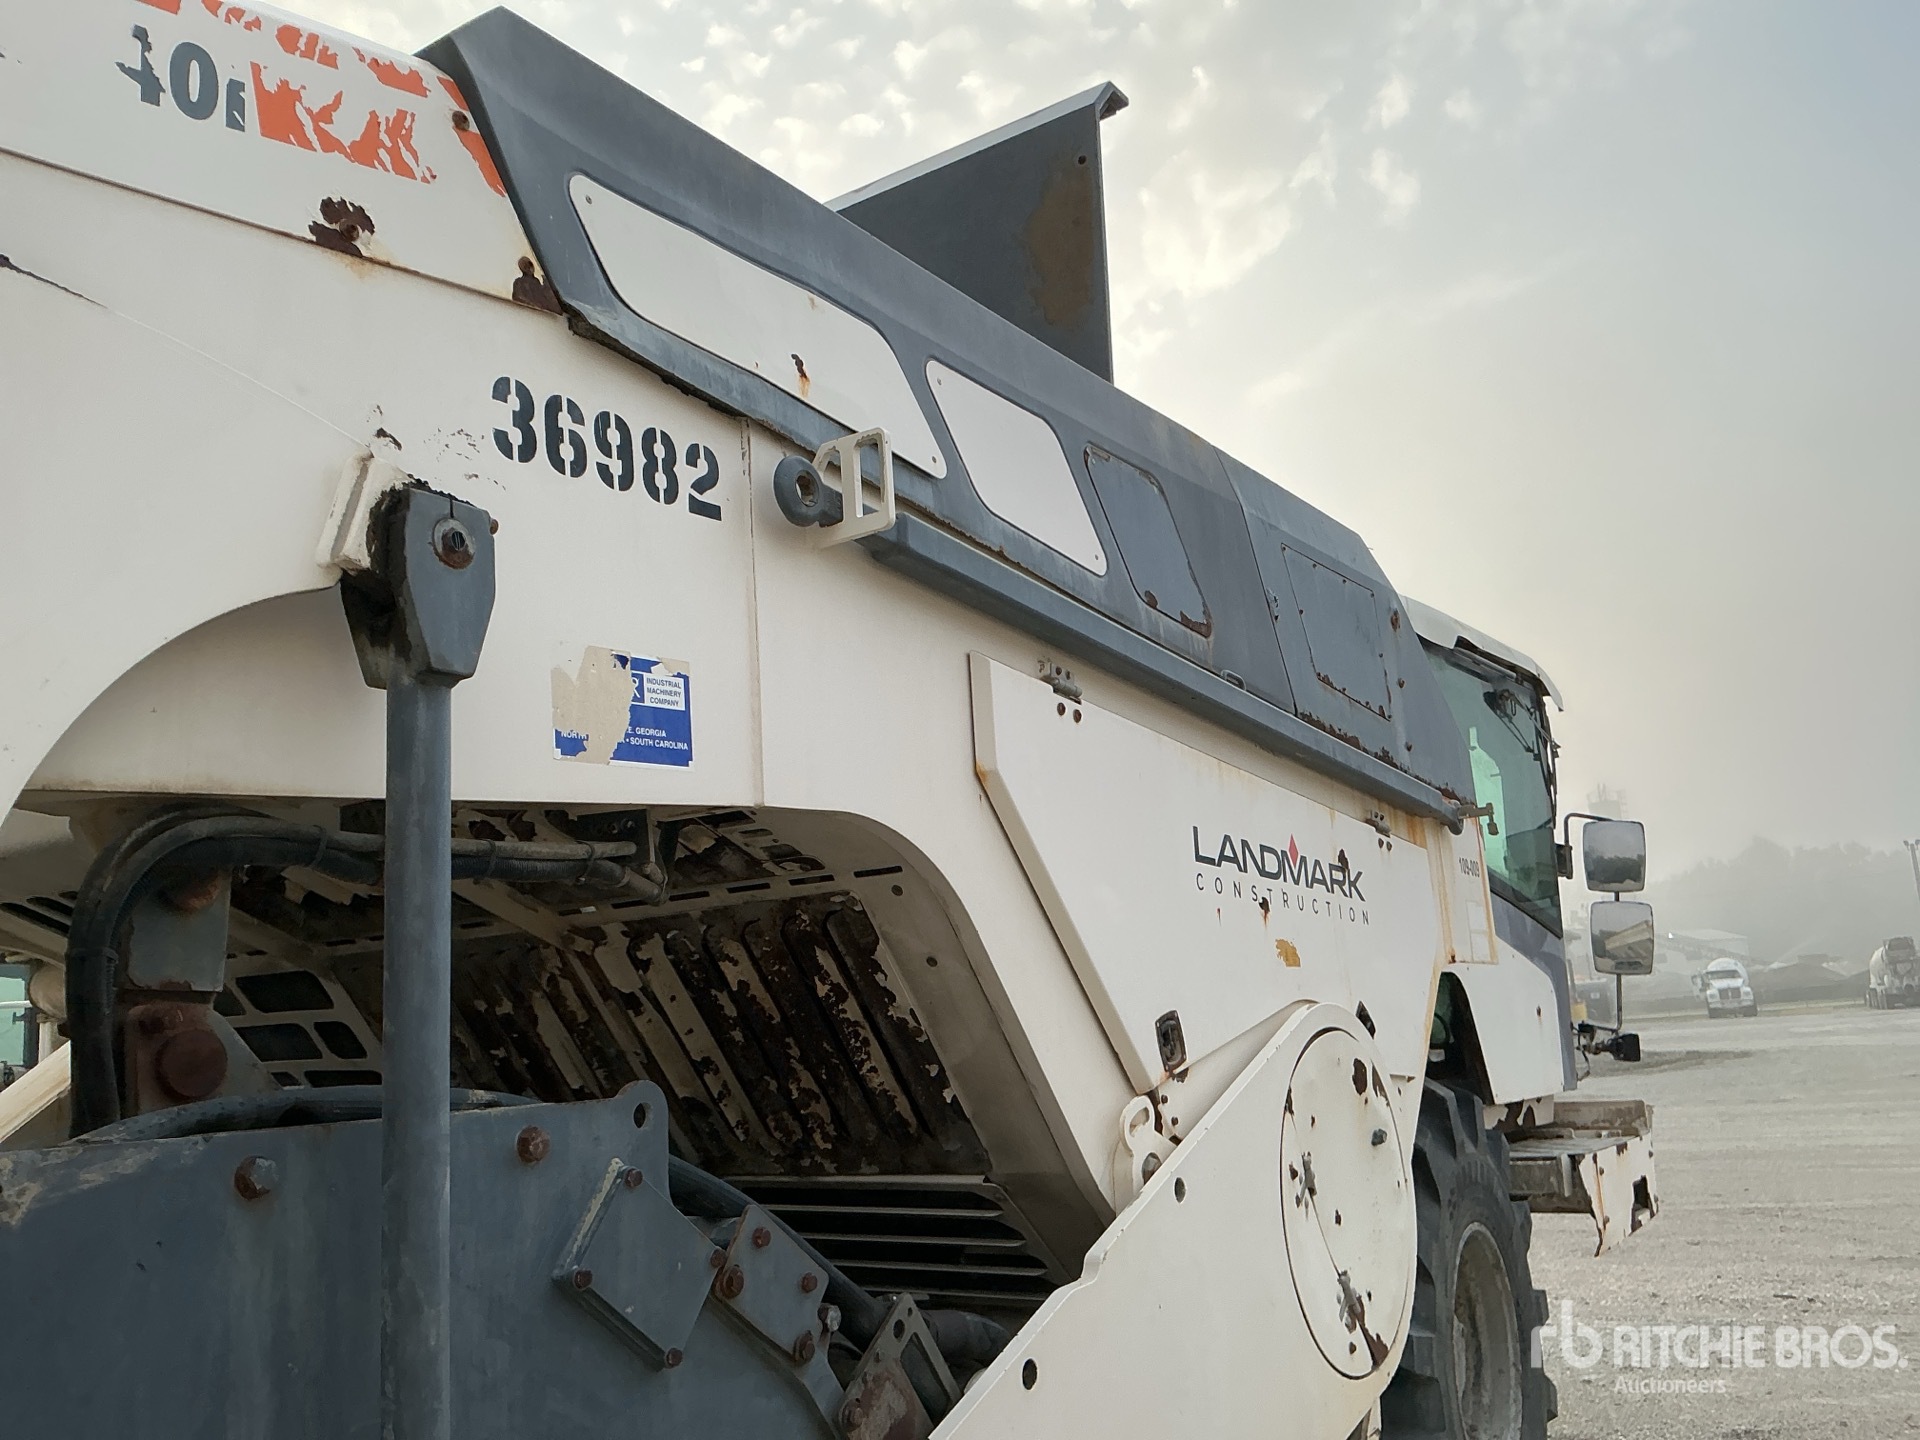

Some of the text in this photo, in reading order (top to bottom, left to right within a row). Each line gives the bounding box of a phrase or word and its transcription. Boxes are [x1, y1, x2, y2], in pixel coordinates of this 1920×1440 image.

[492, 376, 722, 521] 36982
[646, 677, 682, 690] INDUSTRIAL
[646, 687, 682, 698] MACHINERY
[649, 697, 679, 706] COMPANY
[635, 727, 666, 737] GEORGIA
[630, 737, 654, 747] SOUTH
[654, 740, 688, 750] CAROLINA
[1192, 826, 1366, 902] LANDMARK
[1196, 873, 1370, 926] CONSTRUCTION
